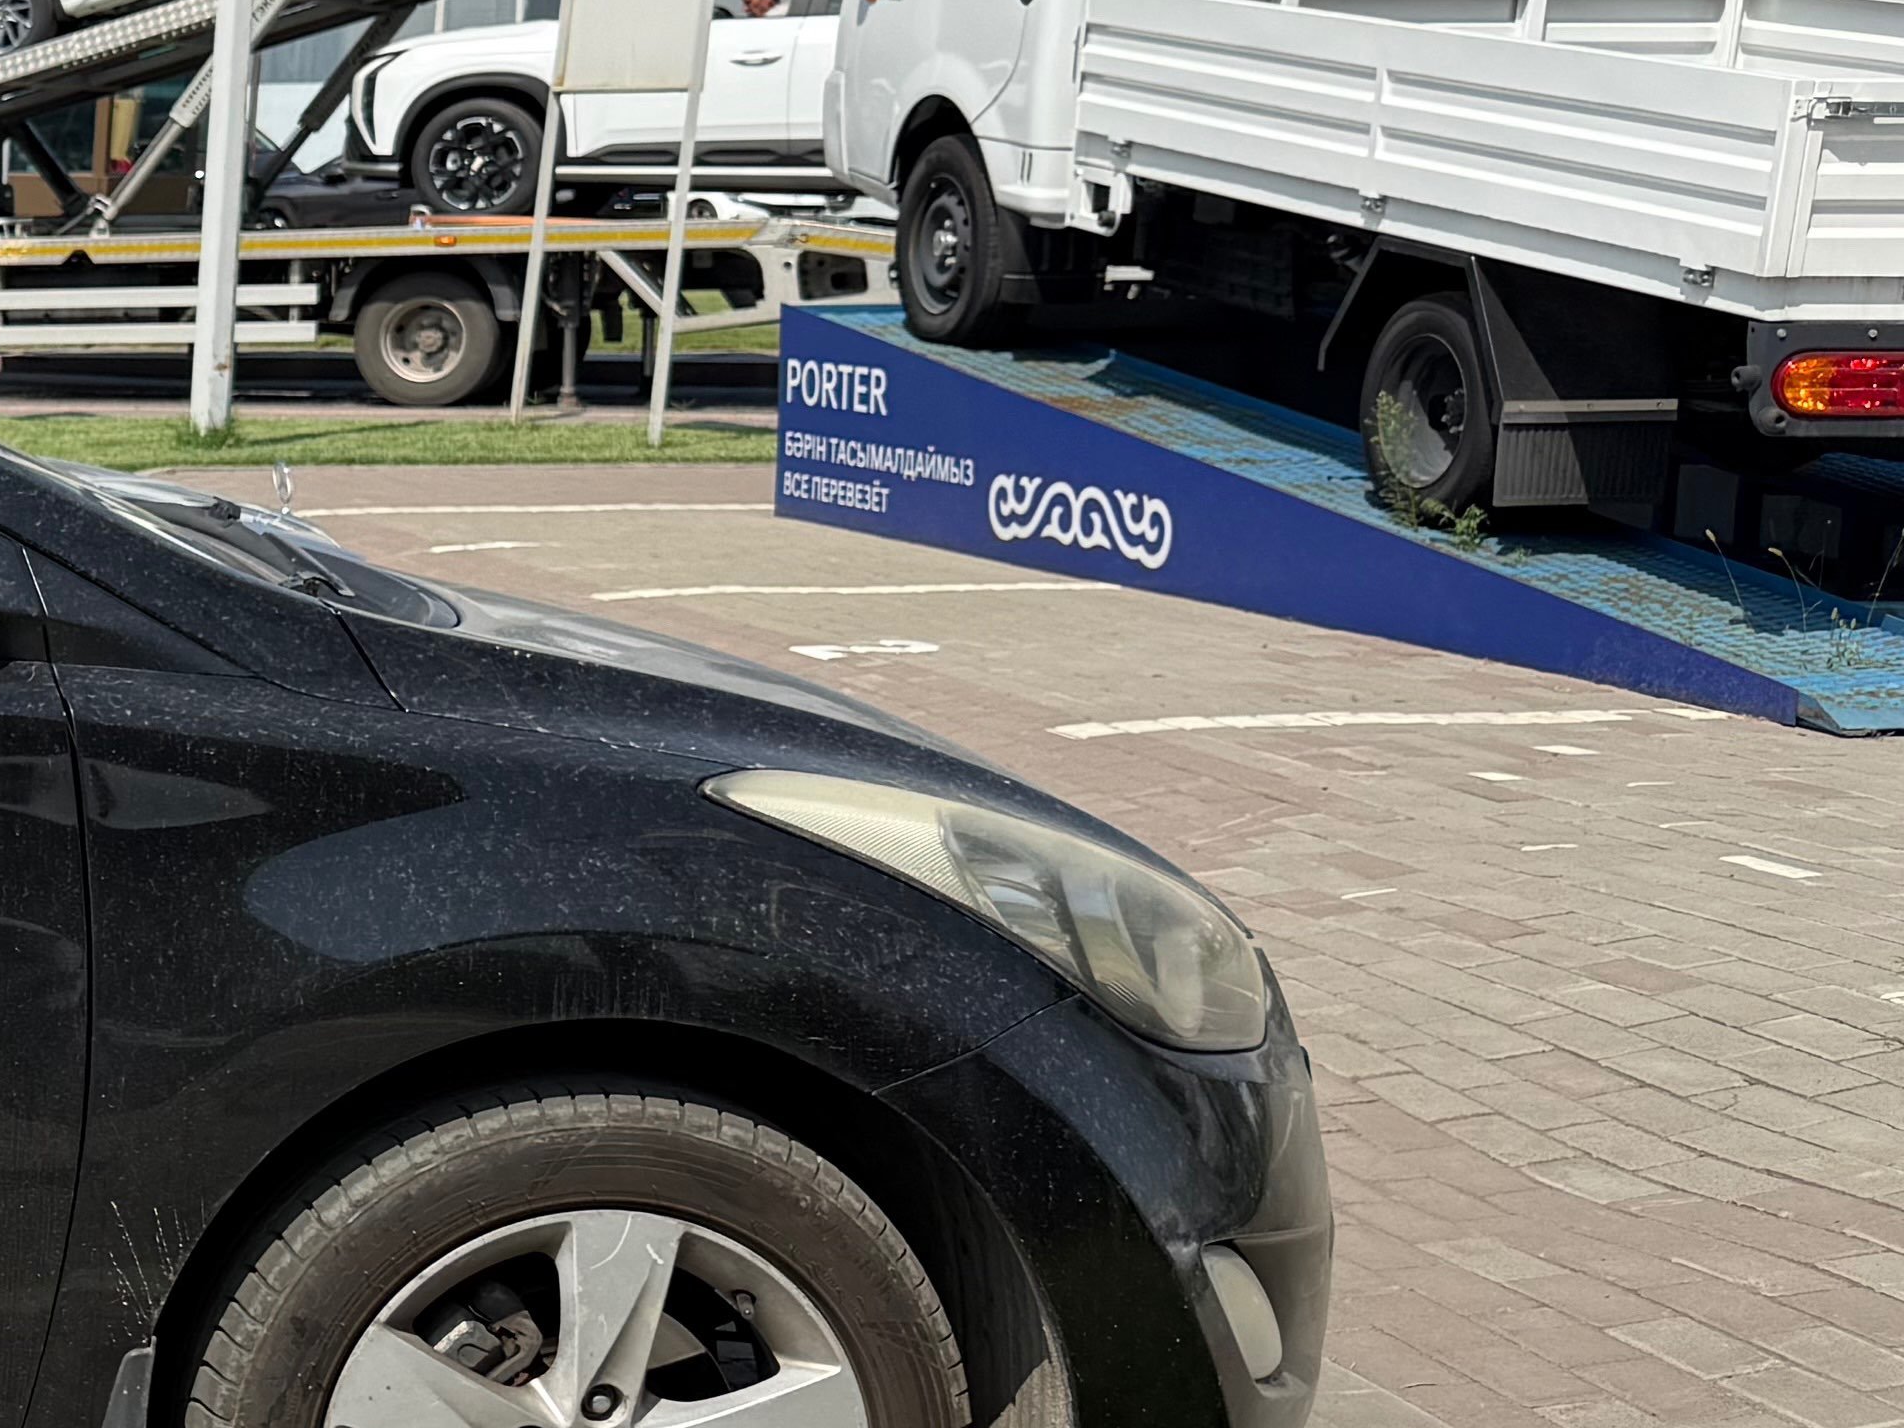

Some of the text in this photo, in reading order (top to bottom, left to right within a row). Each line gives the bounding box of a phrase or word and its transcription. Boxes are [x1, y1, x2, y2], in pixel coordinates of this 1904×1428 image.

[785, 357, 889, 417] PORTER
[784, 429, 975, 487] БӘРІН ТАСЫМАЛДАЙМЫЗ
[782, 470, 891, 514] ВСЕ ПЕРЕВЕЗЁТ
